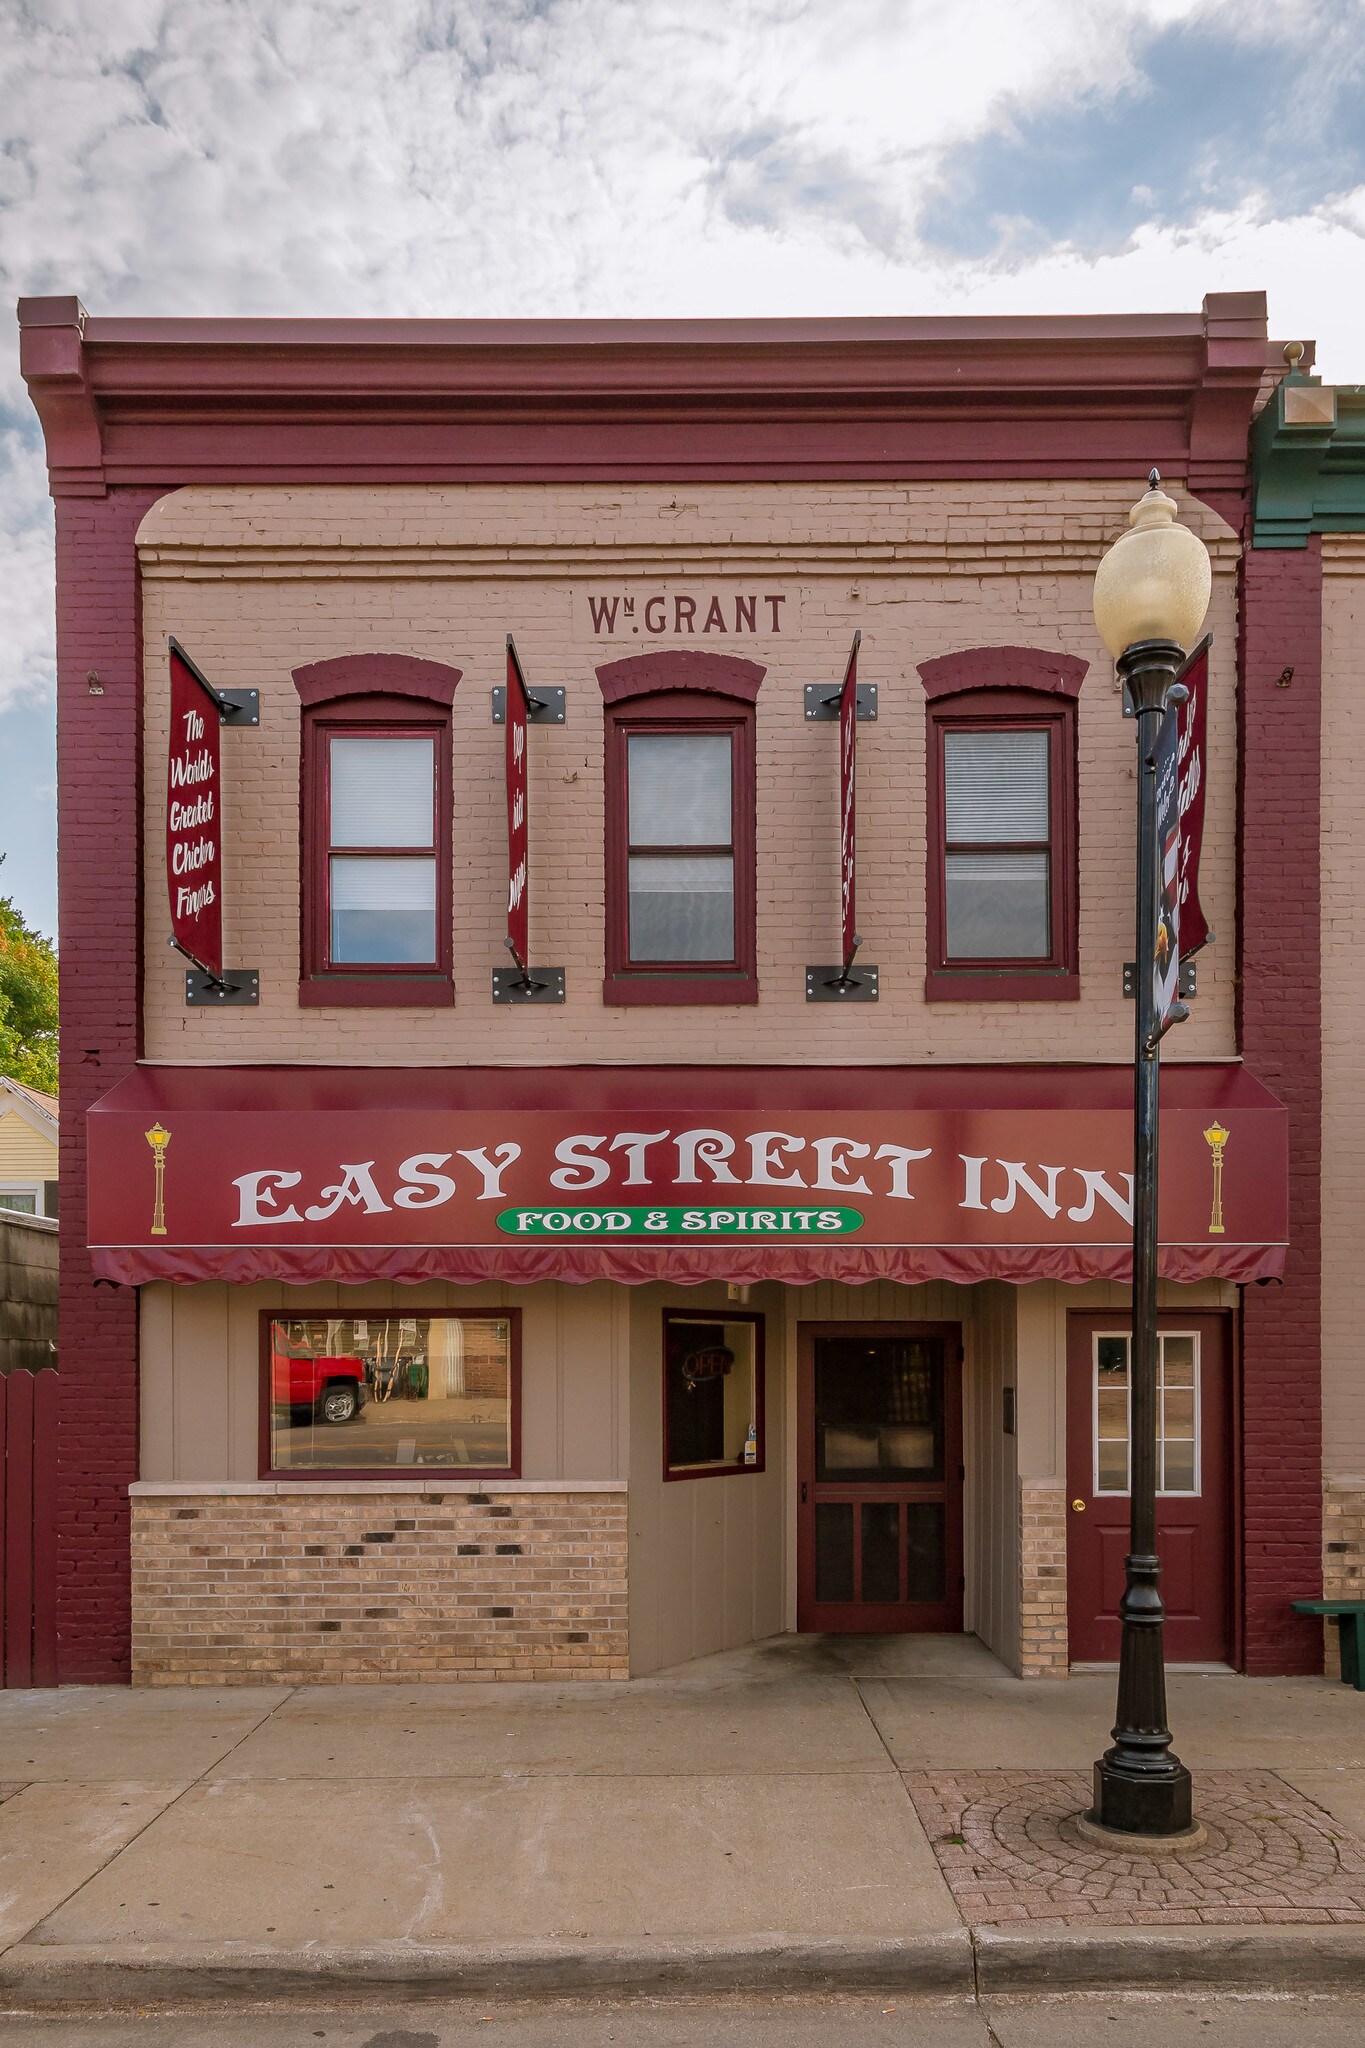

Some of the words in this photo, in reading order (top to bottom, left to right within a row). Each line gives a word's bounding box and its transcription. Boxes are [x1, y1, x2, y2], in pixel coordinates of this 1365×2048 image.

[182, 709, 205, 742] The
[169, 790, 215, 832] Greatet
[231, 1142, 522, 1227] EASY
[549, 1128, 933, 1200] STREET
[958, 1152, 1135, 1227] INN
[516, 1211, 632, 1231] FOOD
[643, 1211, 669, 1231] &
[681, 1211, 844, 1231] SPIRITS
[684, 1353, 732, 1376] OPEN
